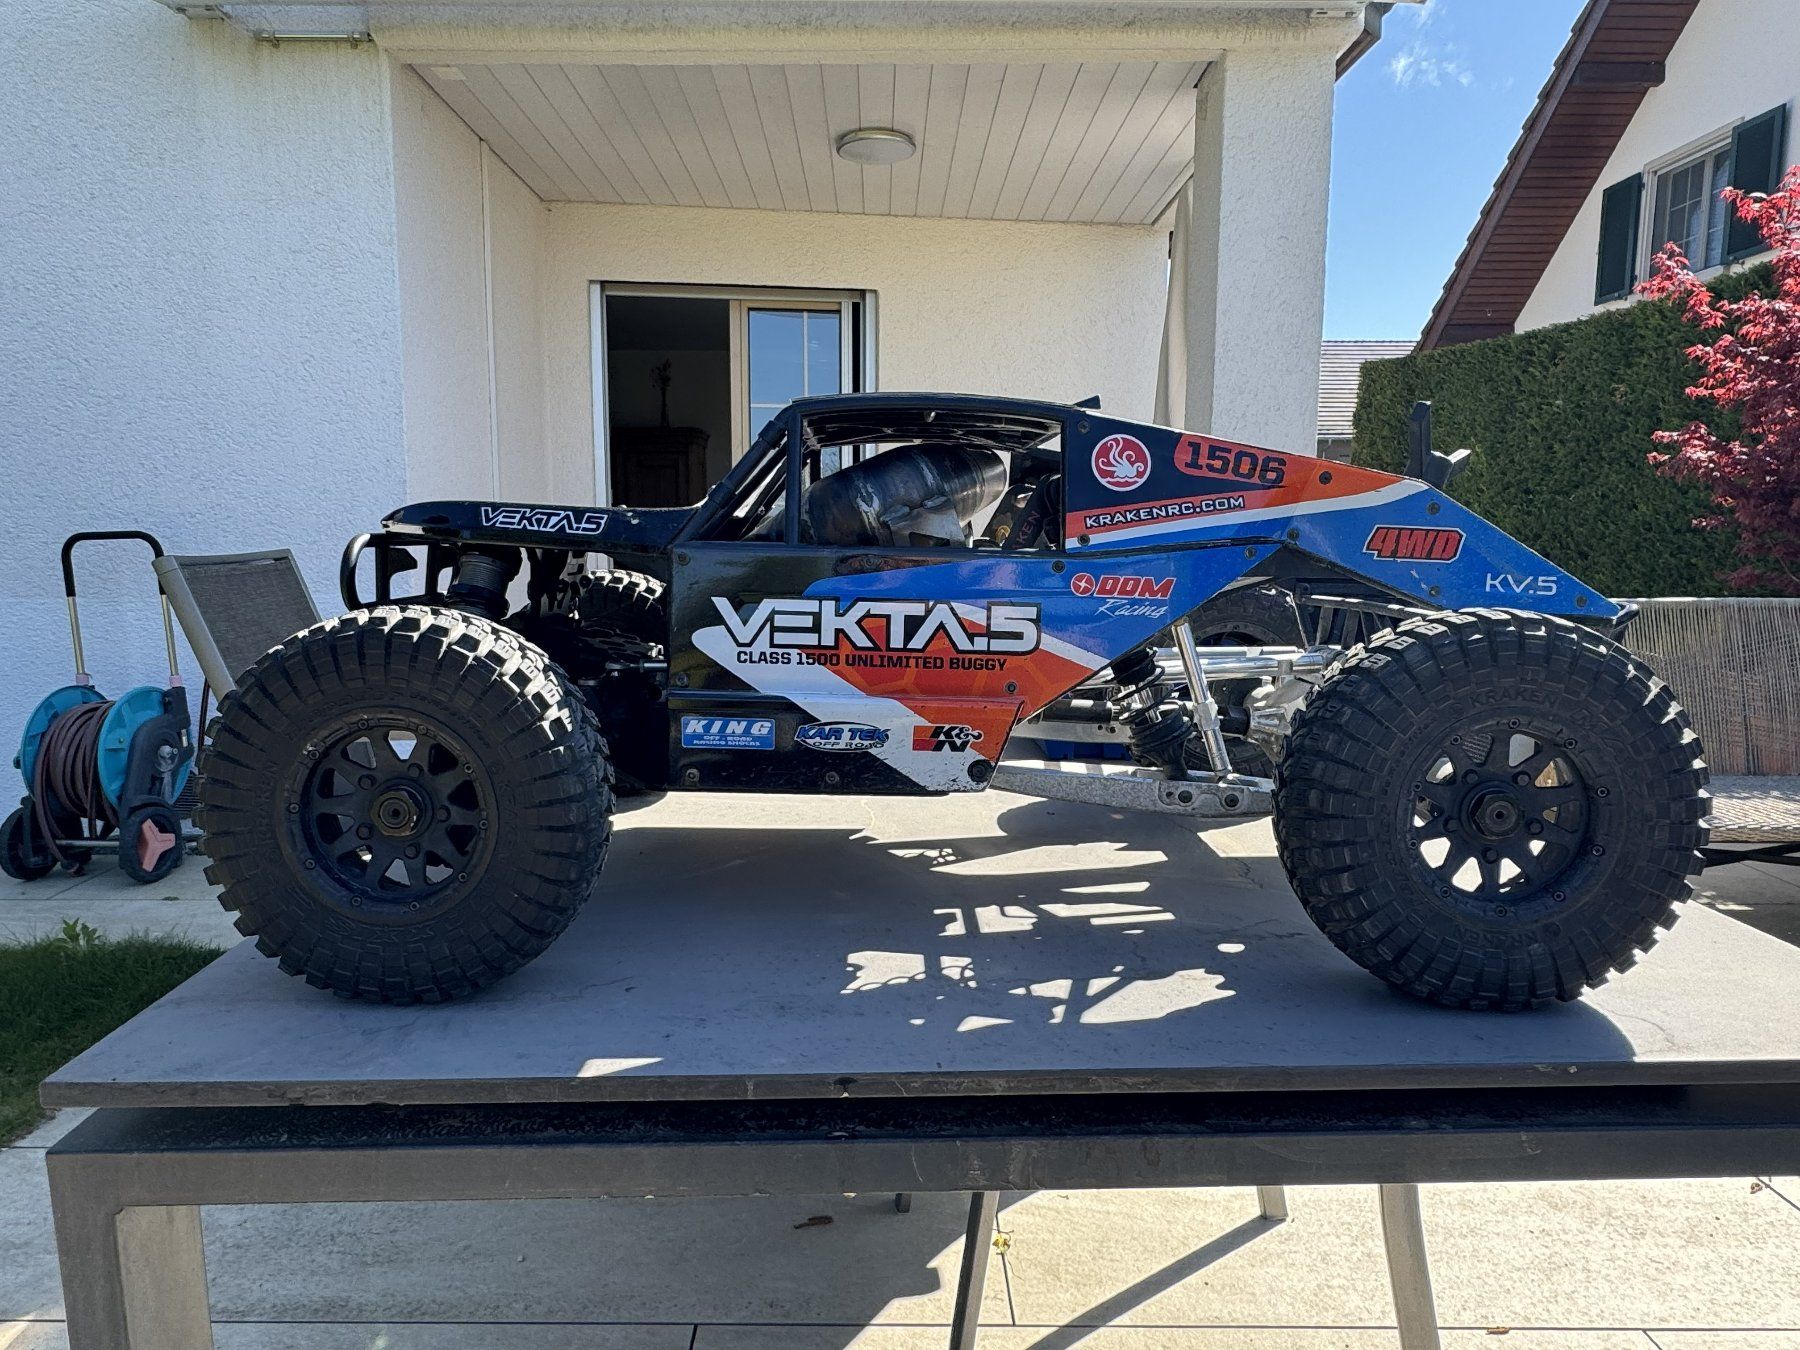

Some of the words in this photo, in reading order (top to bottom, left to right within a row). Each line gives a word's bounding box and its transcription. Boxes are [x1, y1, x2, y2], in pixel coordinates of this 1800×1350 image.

[1184, 441, 1287, 485] 1506
[481, 506, 609, 535] VEKTA.5
[1084, 496, 1246, 529] KRAKENRC.COM
[1368, 527, 1463, 560] 4WD
[1094, 575, 1177, 600] DDM
[1485, 572, 1558, 596] KV.5
[1094, 599, 1169, 619] Racing
[710, 596, 1040, 655] VEKTA.5
[736, 650, 792, 666] CLASS
[796, 651, 841, 667] 1500
[845, 653, 944, 671] UNLIMITED
[949, 654, 1008, 672] BUGGY
[685, 719, 772, 735] KING
[796, 725, 845, 741] KAR
[848, 727, 891, 742] TEK
